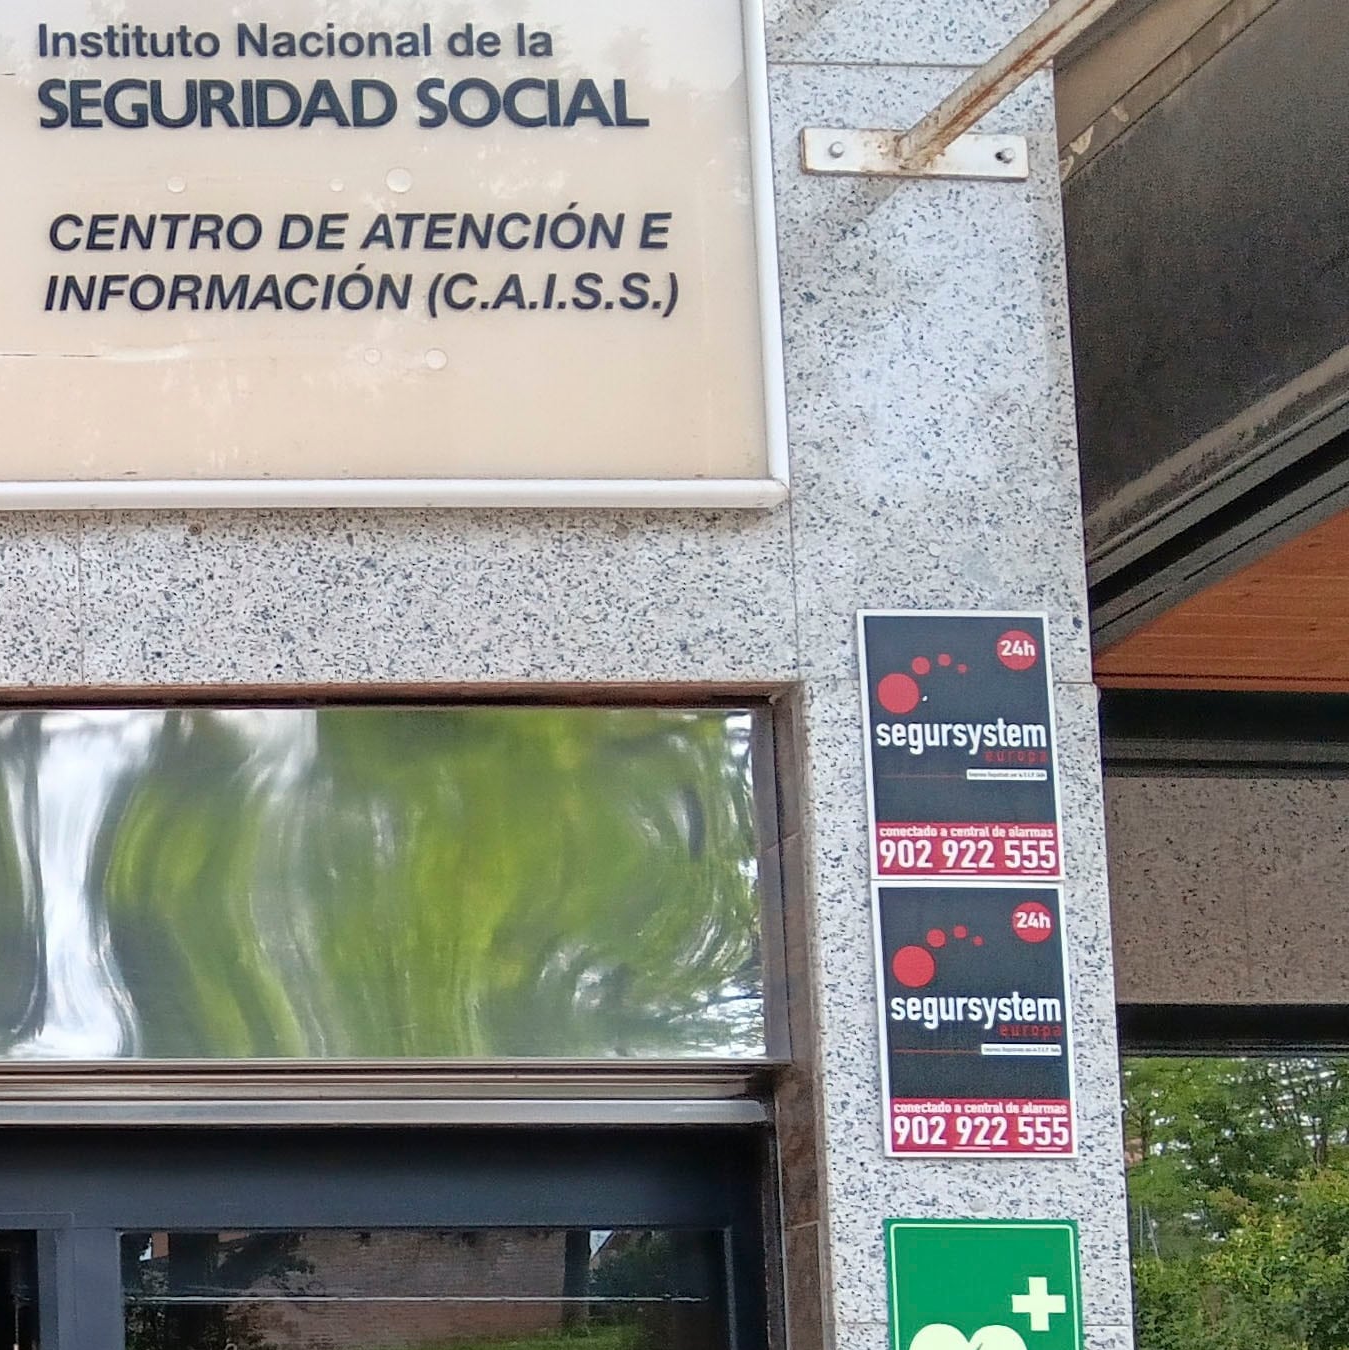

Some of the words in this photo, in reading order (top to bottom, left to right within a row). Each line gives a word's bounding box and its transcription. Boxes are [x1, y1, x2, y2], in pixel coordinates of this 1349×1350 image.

[38, 22, 220, 58] Instituto
[238, 22, 431, 58] Nacional
[447, 22, 501, 58] de
[516, 22, 553, 58] la
[38, 78, 398, 129] SEGURIDAD
[417, 77, 650, 129] SOCIAL
[49, 212, 263, 252] CENTRO
[278, 212, 350, 251] DE
[359, 202, 626, 251] ATENCIÓN
[639, 212, 672, 250] E
[44, 263, 413, 312] INFORMACIÓN
[427, 273, 679, 319] (C.A.I.S.S.)
[1000, 640, 1036, 657] 24h
[875, 717, 1047, 755] segursystem
[879, 825, 937, 837] conectado
[940, 828, 948, 837] a
[951, 826, 990, 837] central
[992, 826, 1006, 838] de
[1008, 825, 1054, 838] alarmas
[879, 839, 933, 868] 902
[942, 839, 995, 868] 922
[1004, 840, 1056, 869] 555
[1016, 911, 1051, 929] 24h
[890, 991, 1062, 1030] segursystem
[998, 1024, 1062, 1039] europa
[893, 1102, 951, 1113] conectado
[954, 1104, 962, 1113] a
[964, 1102, 1003, 1114] central
[1006, 1103, 1020, 1114] de
[1022, 1102, 1067, 1114] alarmas
[893, 1115, 947, 1145] 902
[956, 1116, 1008, 1145] 922
[1018, 1117, 1069, 1146] 555
